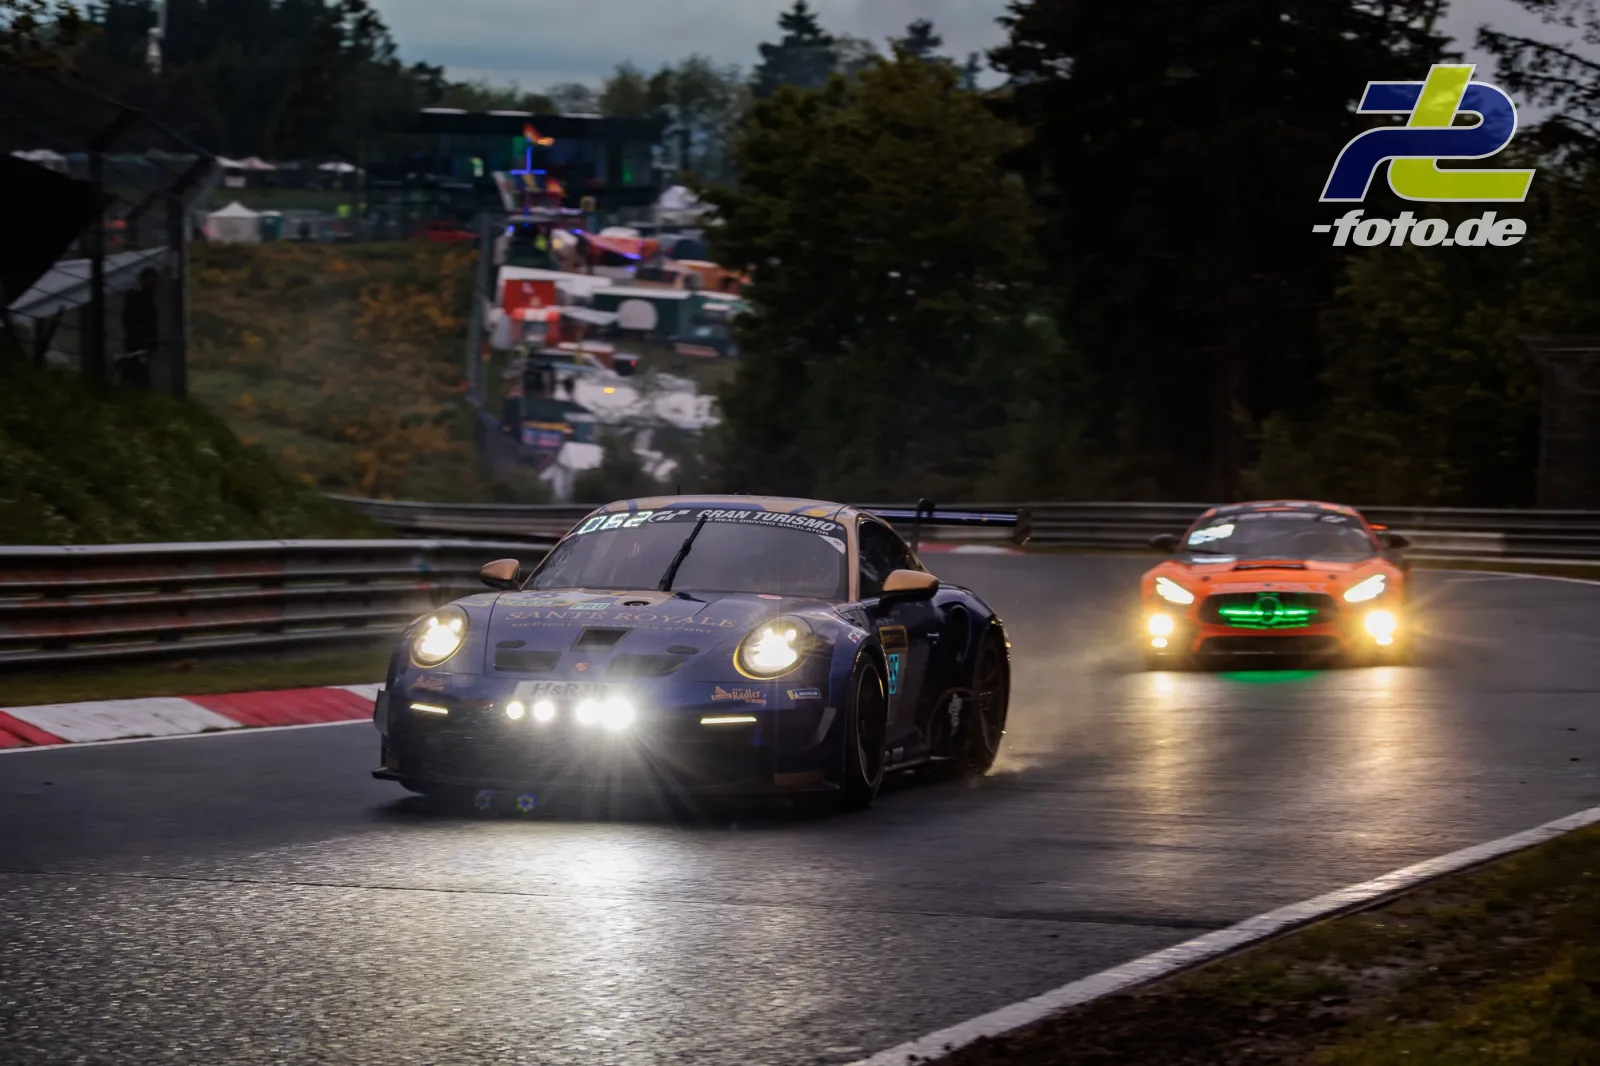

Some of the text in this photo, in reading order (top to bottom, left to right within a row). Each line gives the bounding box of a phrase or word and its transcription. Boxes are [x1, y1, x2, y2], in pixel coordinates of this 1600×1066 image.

[696, 509, 838, 532] GRAN TURISMO
[740, 519, 778, 527] DRIVING
[778, 523, 830, 536] SIMULATOR
[613, 612, 738, 628] ROYALE
[531, 682, 579, 697] H&R
